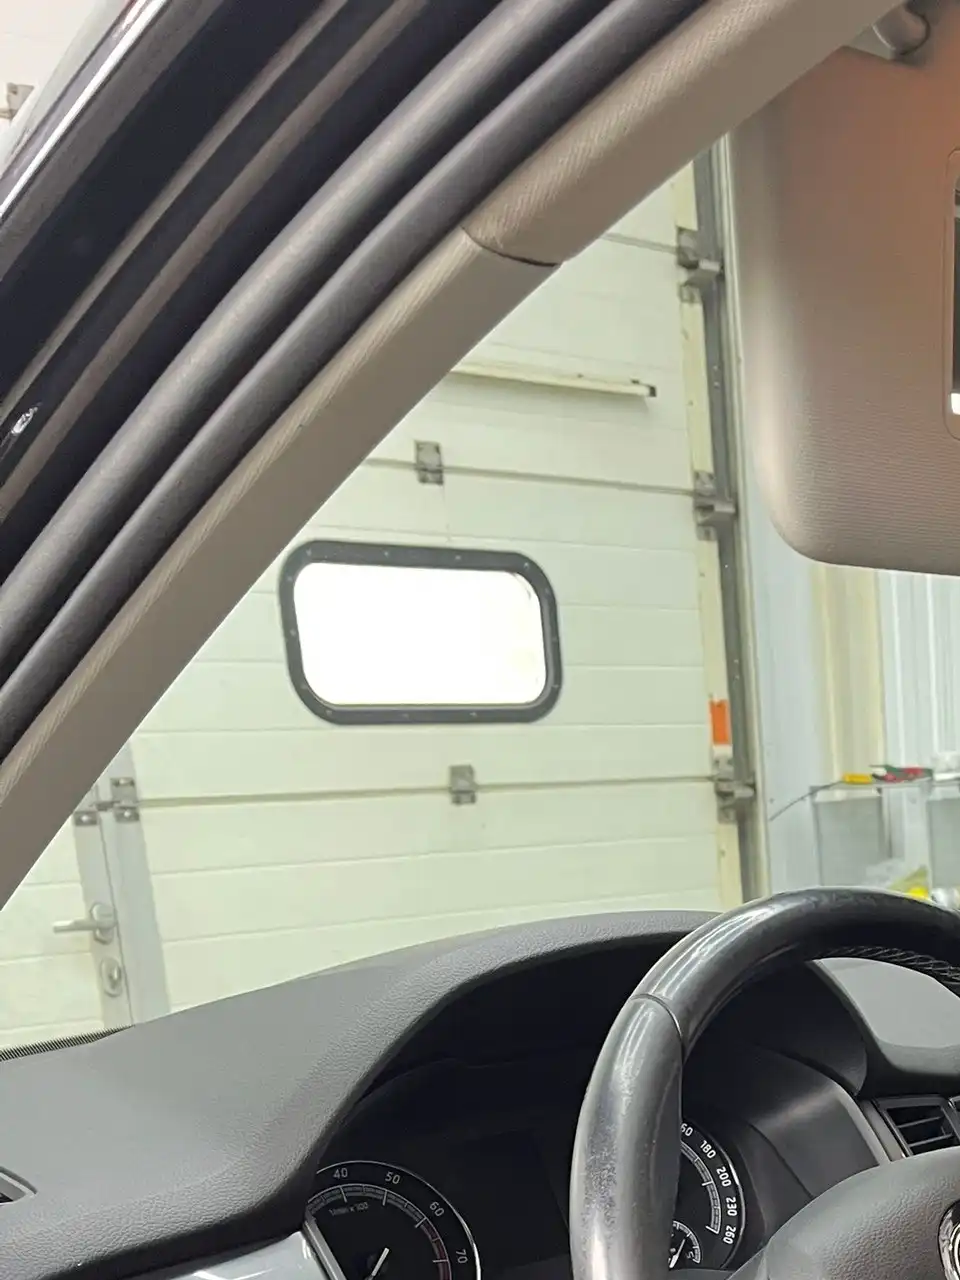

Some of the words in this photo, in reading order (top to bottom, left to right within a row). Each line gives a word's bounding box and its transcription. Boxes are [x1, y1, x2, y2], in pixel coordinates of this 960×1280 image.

[679, 1122, 694, 1137] 60
[699, 1139, 717, 1159] 180
[333, 1167, 348, 1179] 40
[384, 1170, 401, 1185] 50
[716, 1166, 732, 1187] 200
[429, 1201, 445, 1217] 60
[725, 1196, 738, 1217] 230
[722, 1225, 737, 1245] 260
[455, 1249, 469, 1264] 70
